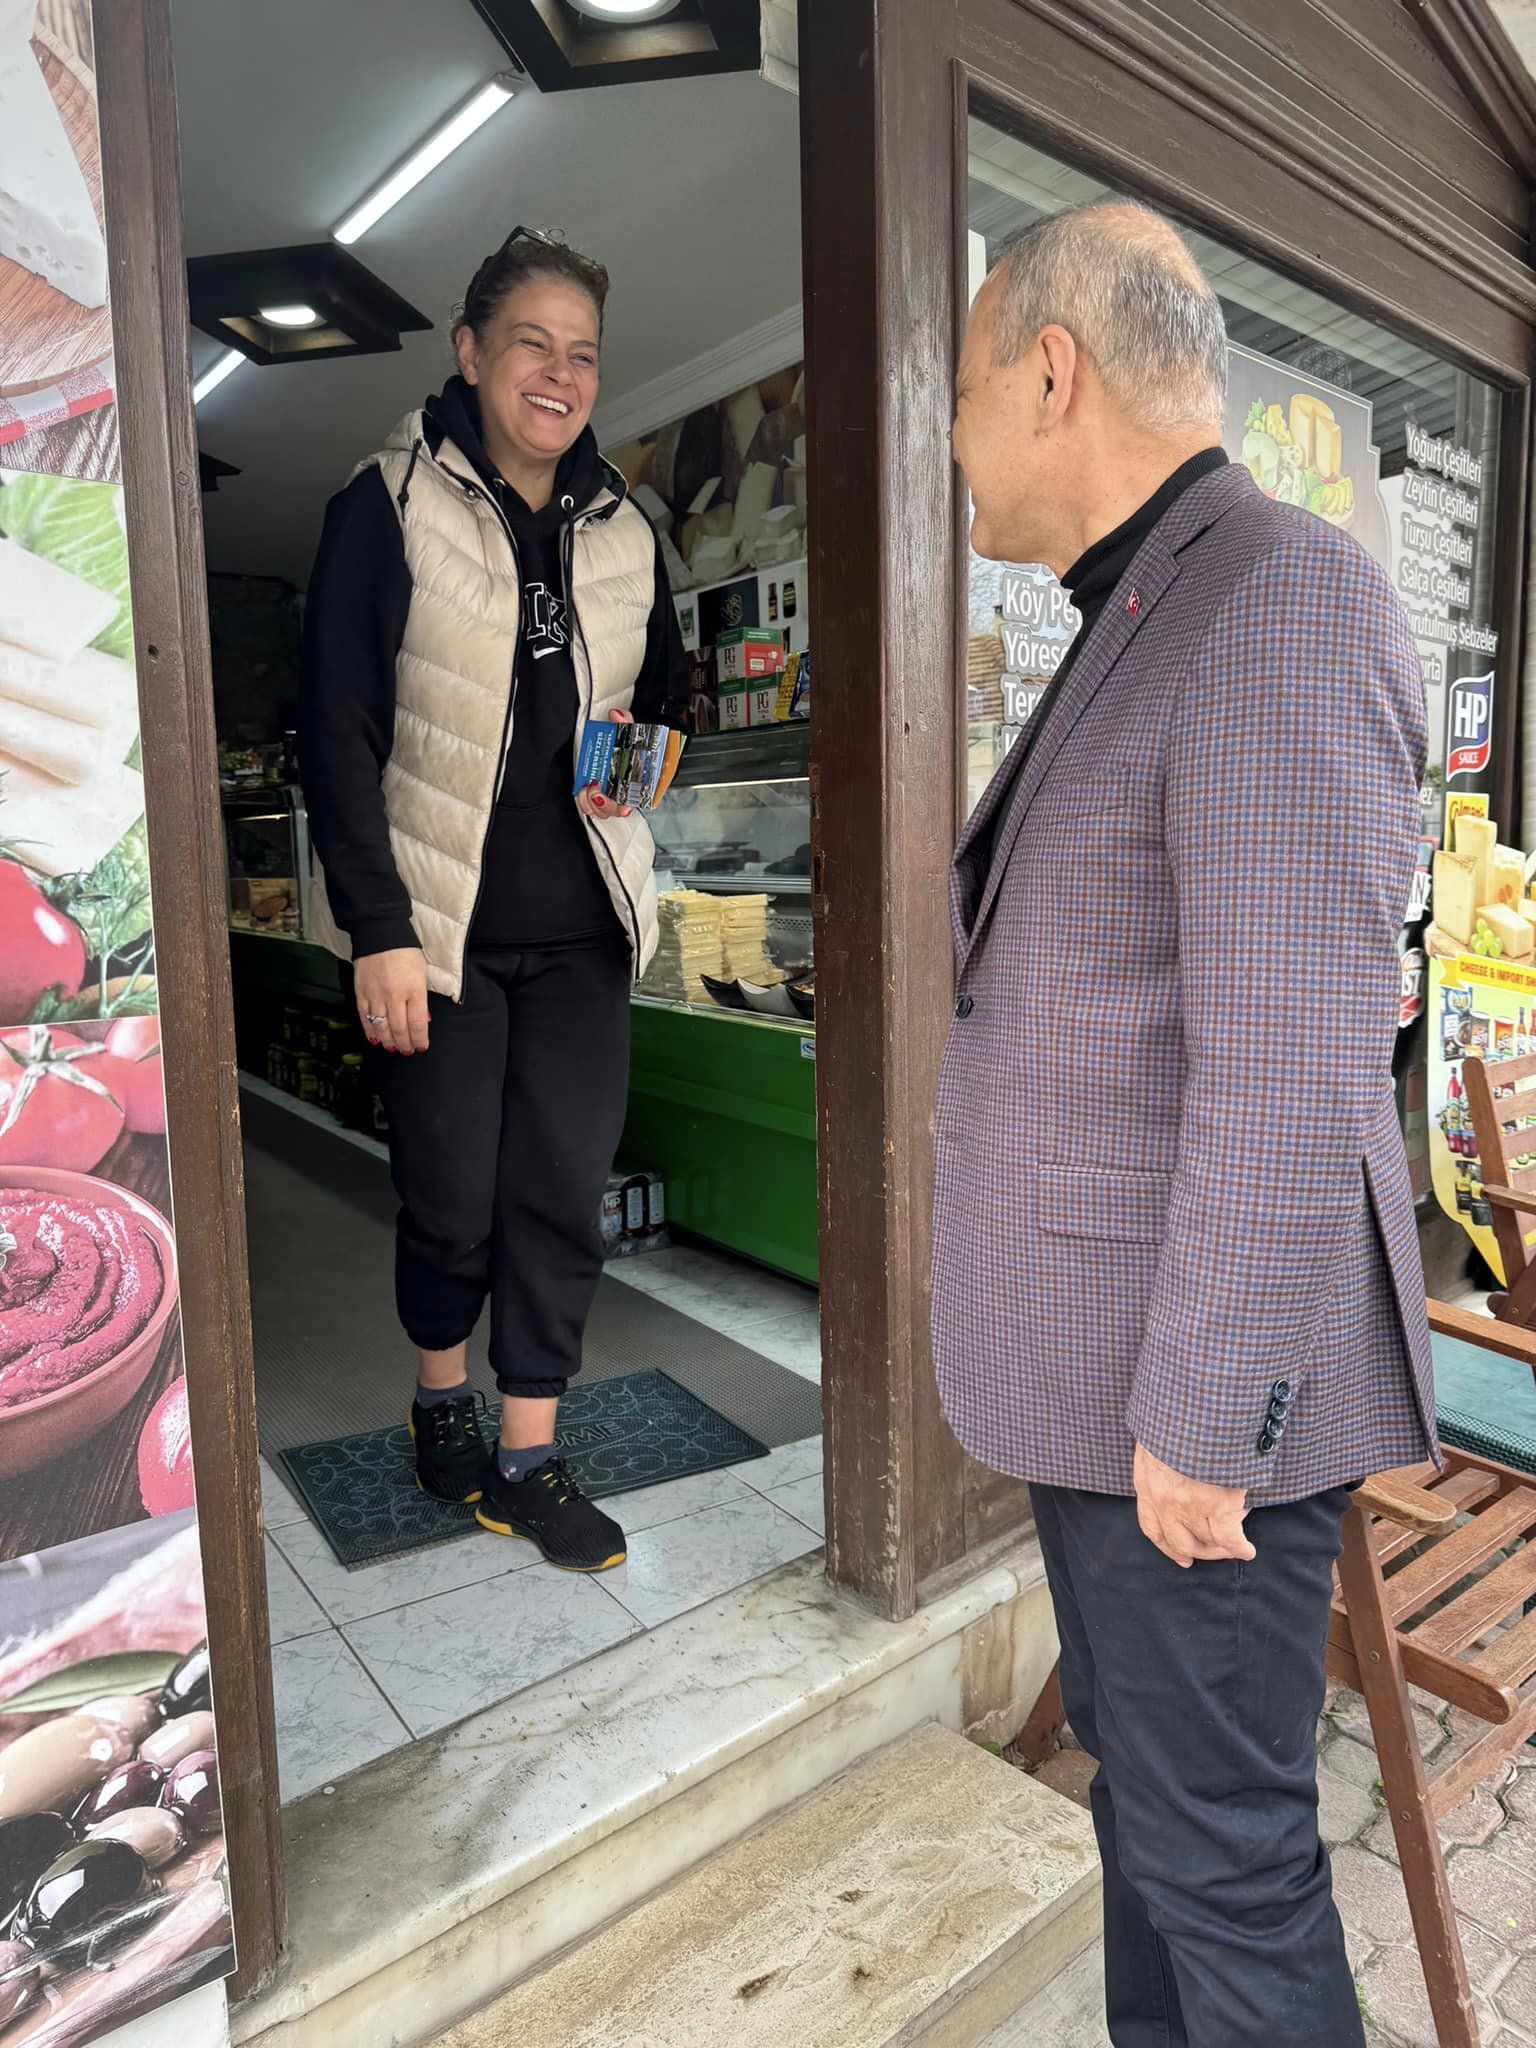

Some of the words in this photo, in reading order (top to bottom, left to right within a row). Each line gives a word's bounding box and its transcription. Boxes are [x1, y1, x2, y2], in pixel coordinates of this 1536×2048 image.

[1407, 426, 1442, 465] Yoğurt
[1443, 445, 1482, 484] Çeşitleri
[1405, 473, 1438, 507] Zeytin
[1439, 487, 1478, 524] Çeşitleri
[1403, 518, 1432, 551] Turşu
[1433, 529, 1472, 563] Çeşitleri
[1006, 578, 1045, 624] Köy
[1401, 562, 1429, 594] Salça
[1431, 571, 1470, 605] Çeşitleri
[1405, 609, 1458, 646] urutulmuş
[1459, 622, 1498, 653] Sebzeler
[1454, 689, 1488, 739] HP
[1457, 751, 1479, 766] SAUCE
[1459, 961, 1488, 977] CHEESE
[1497, 969, 1524, 985] IMPORT
